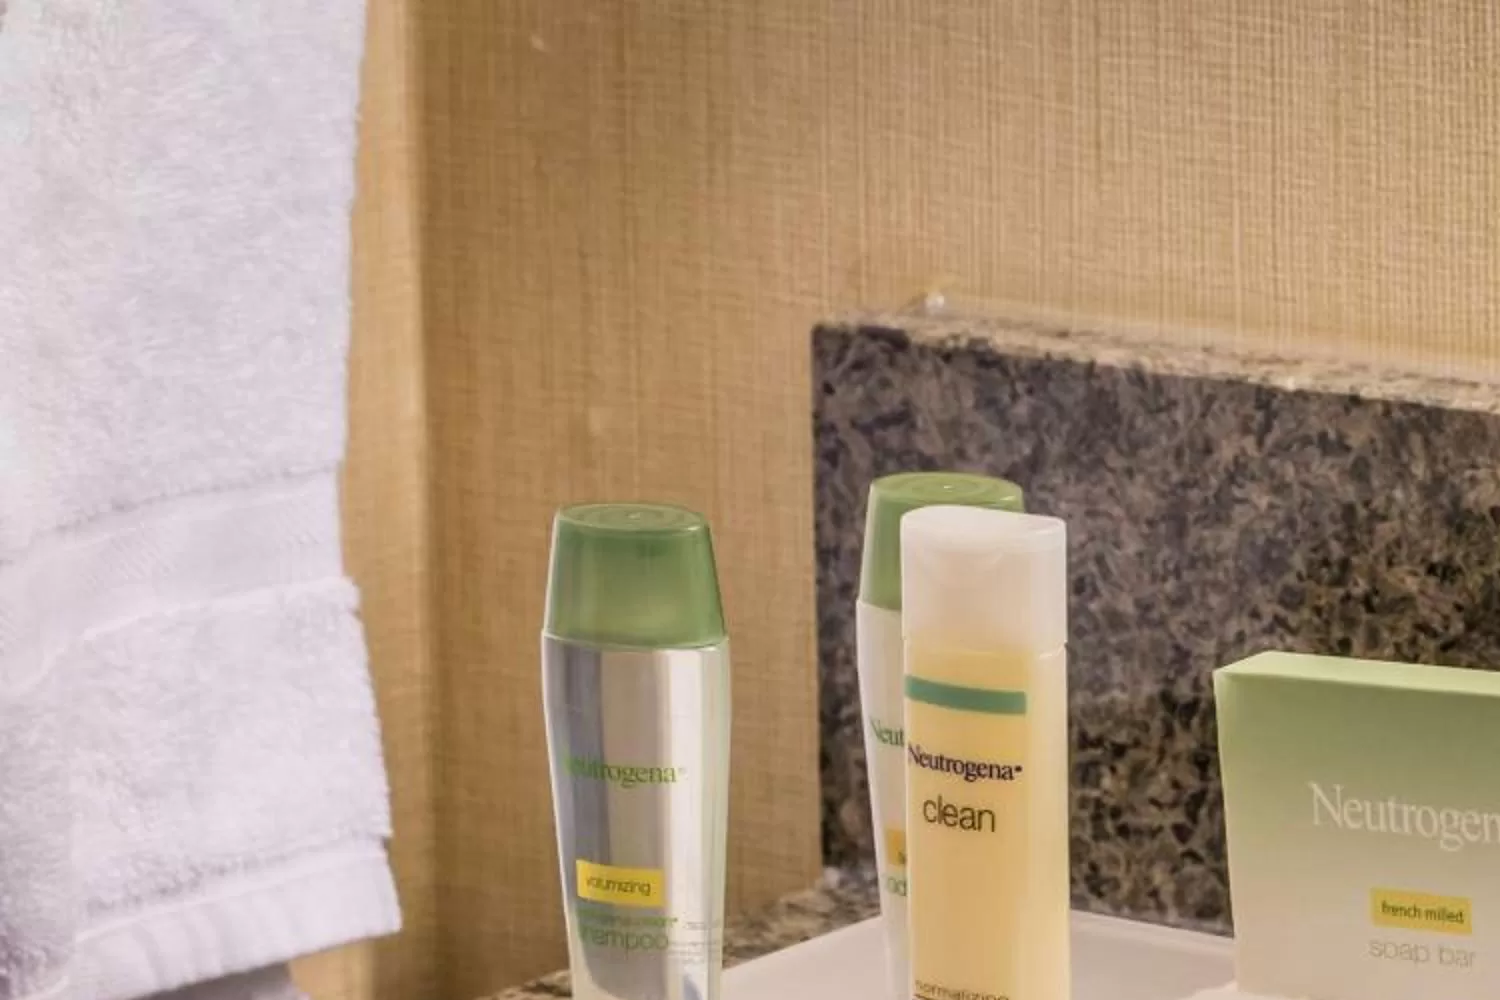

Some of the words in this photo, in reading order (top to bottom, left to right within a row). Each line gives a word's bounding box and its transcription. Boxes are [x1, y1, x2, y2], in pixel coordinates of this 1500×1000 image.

[565, 754, 677, 789] eutrogena
[907, 741, 1015, 782] Neutrogena
[922, 794, 996, 833] clean
[585, 875, 652, 897] volumizing
[1381, 899, 1422, 920] french
[1425, 903, 1465, 924] milled
[1368, 939, 1431, 965] soap
[1439, 942, 1476, 968] bar
